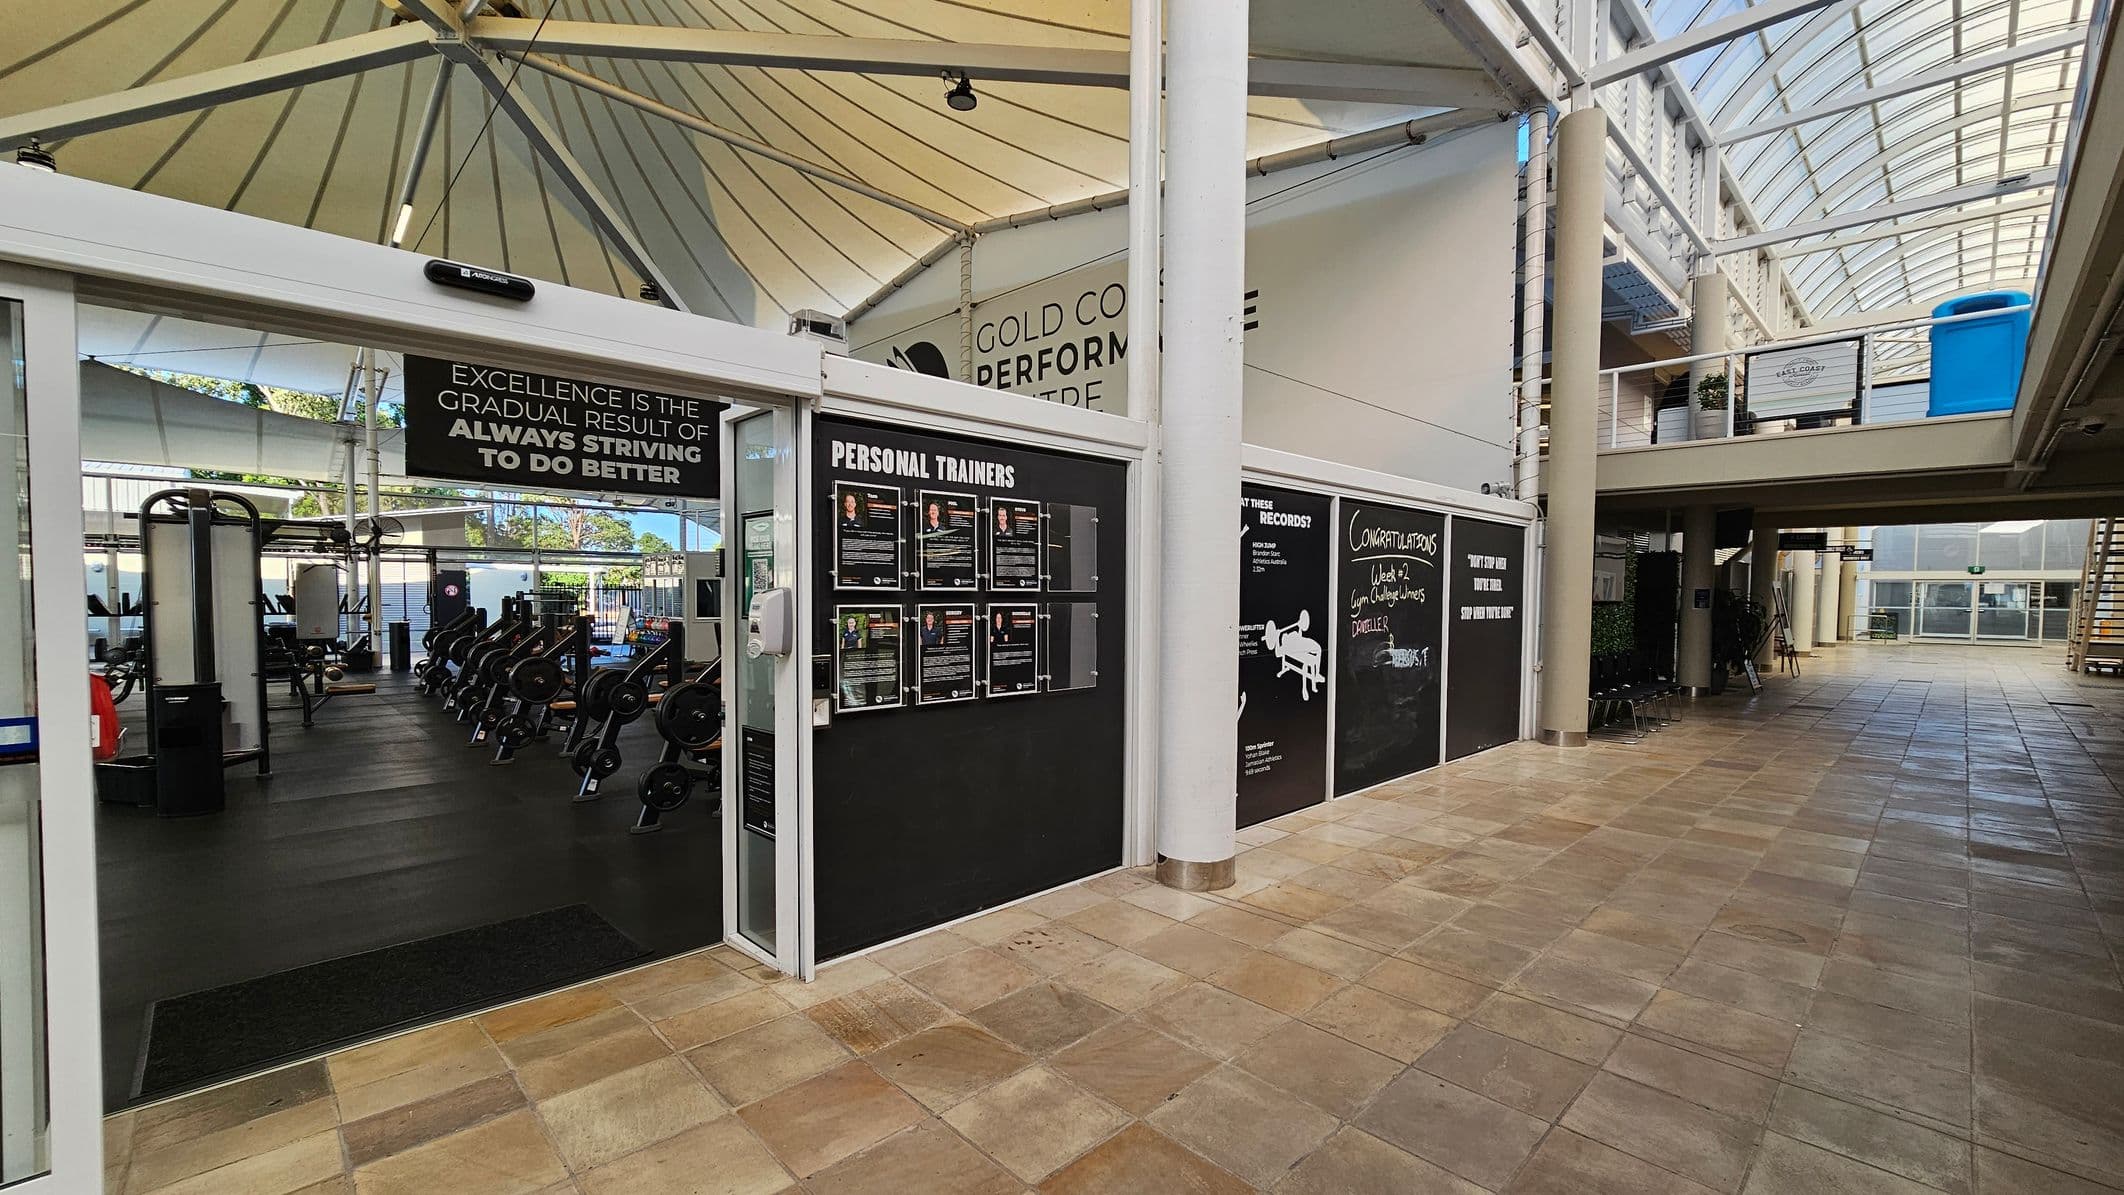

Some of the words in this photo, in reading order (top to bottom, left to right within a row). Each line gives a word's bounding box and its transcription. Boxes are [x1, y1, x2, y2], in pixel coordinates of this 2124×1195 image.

[976, 303, 1064, 353] GOLD
[1776, 367, 1797, 378] EAST
[1799, 365, 1826, 373] COAST
[452, 364, 623, 408] EXCELLENCE
[631, 392, 650, 412] IS
[655, 396, 700, 419] THE
[438, 390, 577, 427] GRADUAL
[585, 410, 673, 438] RESULT
[678, 423, 710, 441] OF
[448, 418, 576, 451] ALWAYS
[582, 434, 702, 463] STRIVING
[478, 447, 521, 470] TO
[529, 453, 574, 475] DO
[581, 458, 681, 484] BETTER
[831, 440, 930, 480] PERSONAL
[935, 455, 1016, 489] TRAINERS
[1250, 498, 1274, 510] THESE
[1260, 511, 1312, 529] RECORDS?
[1349, 509, 1437, 556] CONGRATULATIONS
[1371, 563, 1397, 586] Week
[1350, 589, 1369, 618] Gym
[1370, 584, 1399, 607] Challenge
[1399, 584, 1426, 603] Winners
[1257, 741, 1275, 750] Sprinter
